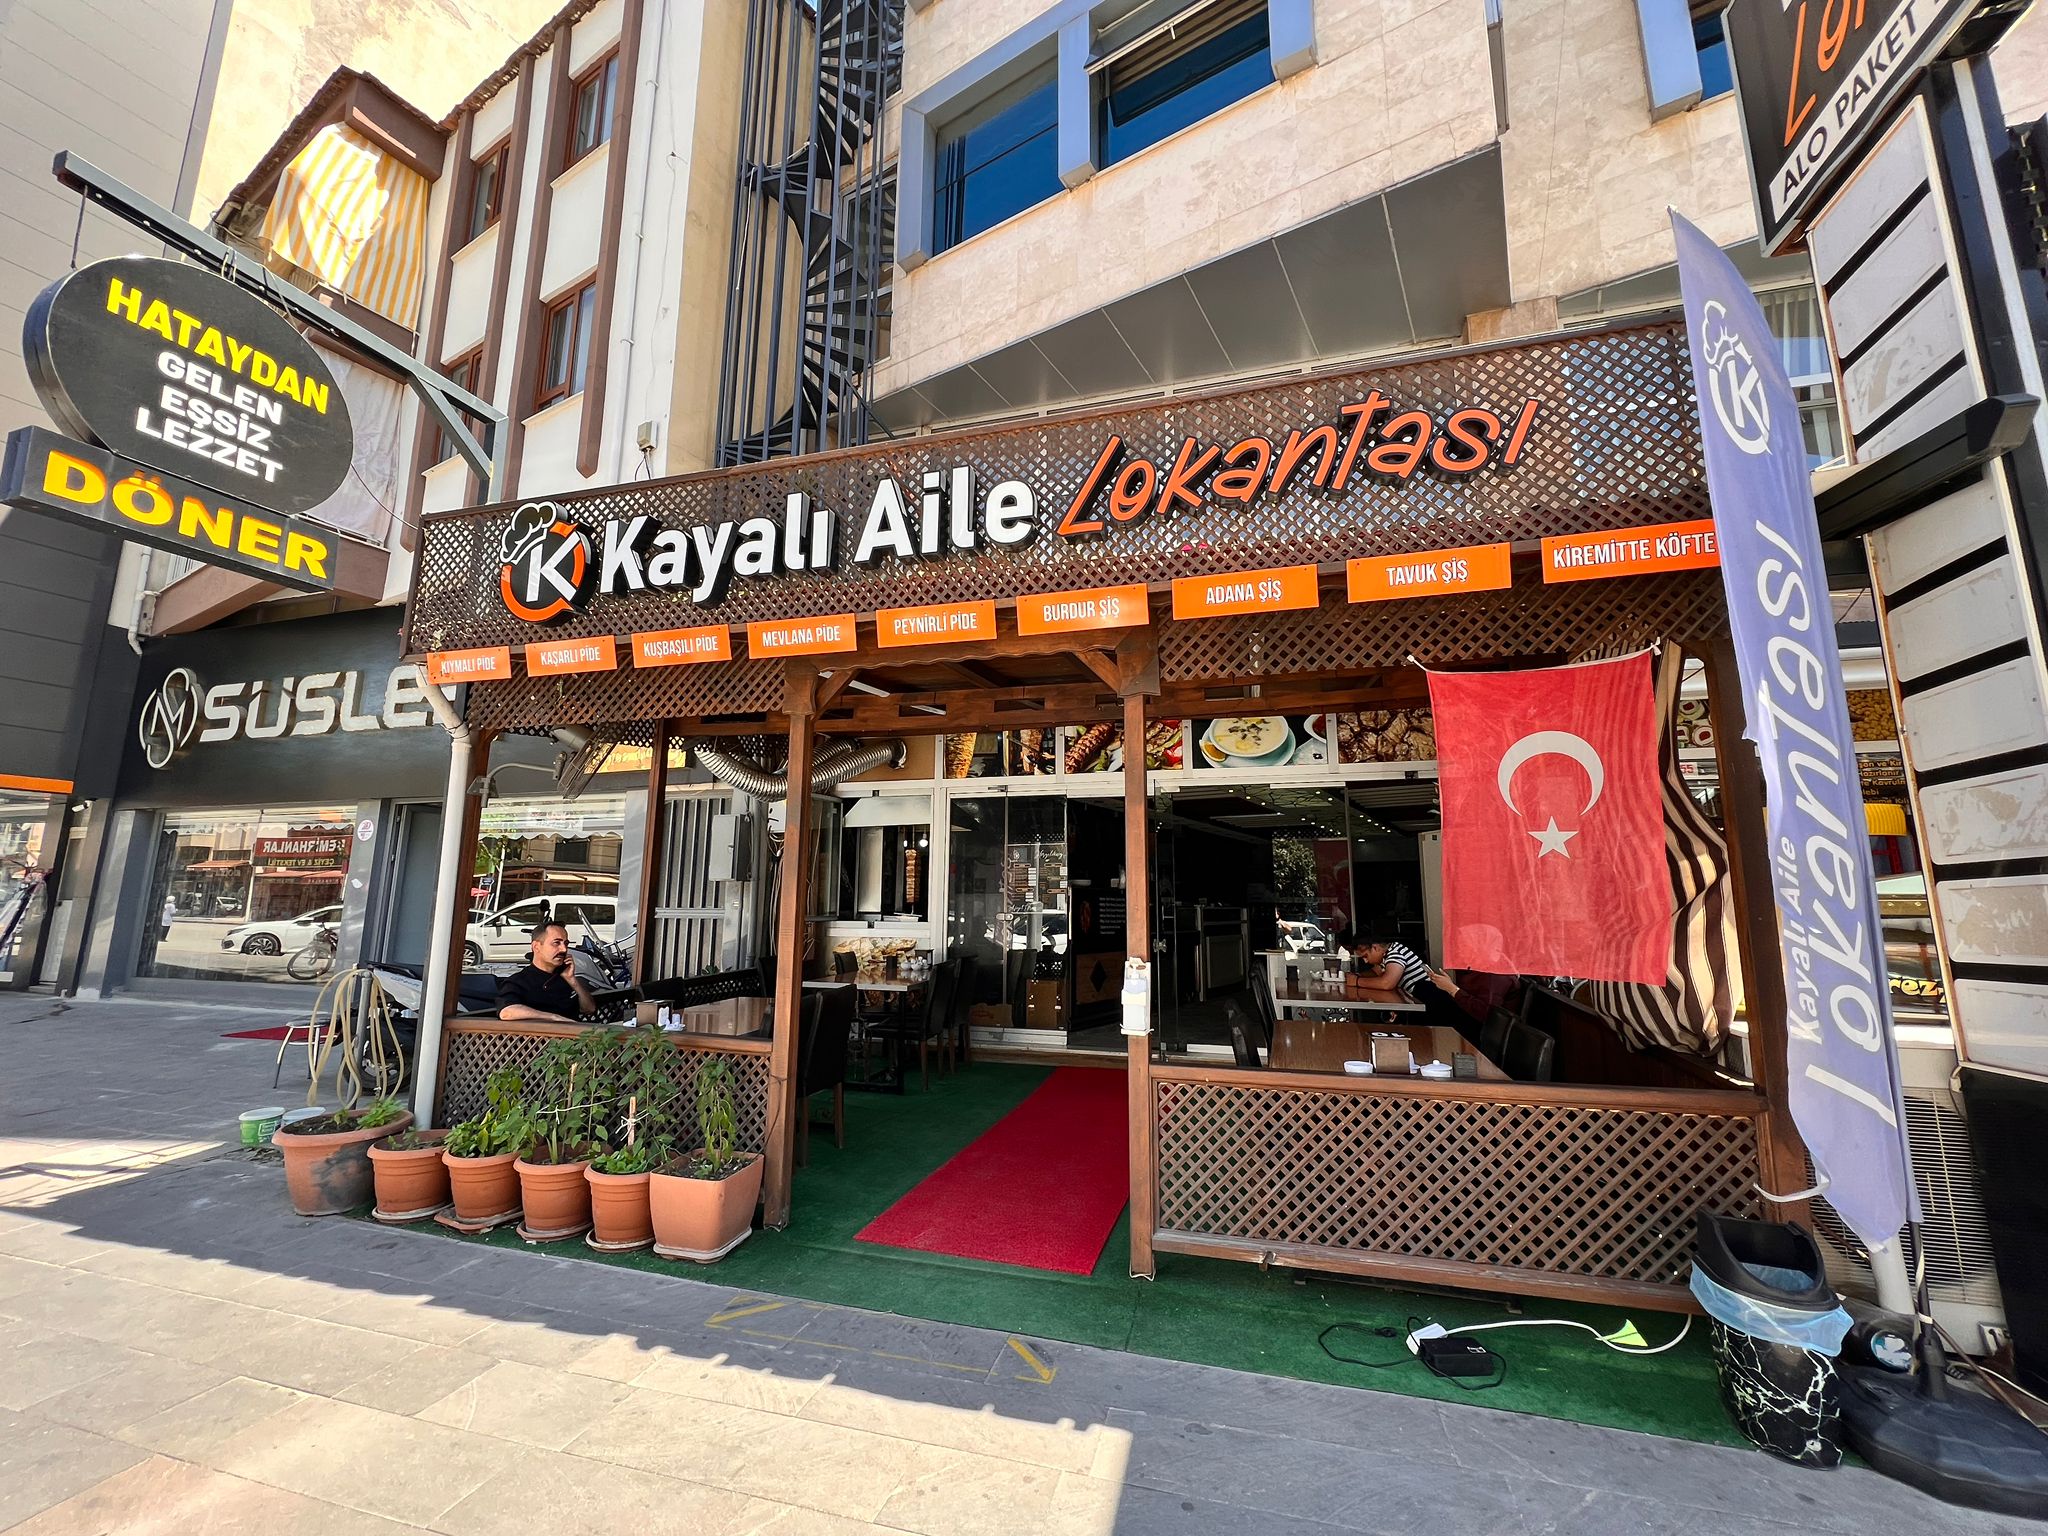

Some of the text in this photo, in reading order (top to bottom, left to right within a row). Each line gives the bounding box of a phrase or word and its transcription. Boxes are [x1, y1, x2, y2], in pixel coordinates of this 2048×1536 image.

[1782, 2, 1919, 204] ALO PAKET
[106, 278, 329, 415] HATAYDAN
[157, 352, 283, 426] GELEN
[135, 407, 284, 484] LEZZET
[160, 386, 272, 452] EŞSİZ
[43, 450, 328, 580] DÖNER
[600, 389, 1539, 606] Kayalı Aile Lokantası
[1385, 557, 1469, 587] TAVUK ŞİŞ
[1553, 530, 1716, 570] KİREMİTTE KÖFTE
[1043, 595, 1121, 623] BURDUR ŞİŞ
[1205, 577, 1283, 606] ADANA ŞİŞ
[643, 634, 719, 658] KUŞBAŞILI PİDE
[762, 624, 841, 648] MEVLANA PİDE
[893, 610, 978, 635] PEYNİRLİ PİDE
[441, 655, 497, 675] KIYMALI PİDE
[540, 645, 601, 667] KAŞARLI PİDE
[199, 664, 457, 743] SÜSLE
[1777, 835, 1823, 1046] Kayalı Aile
